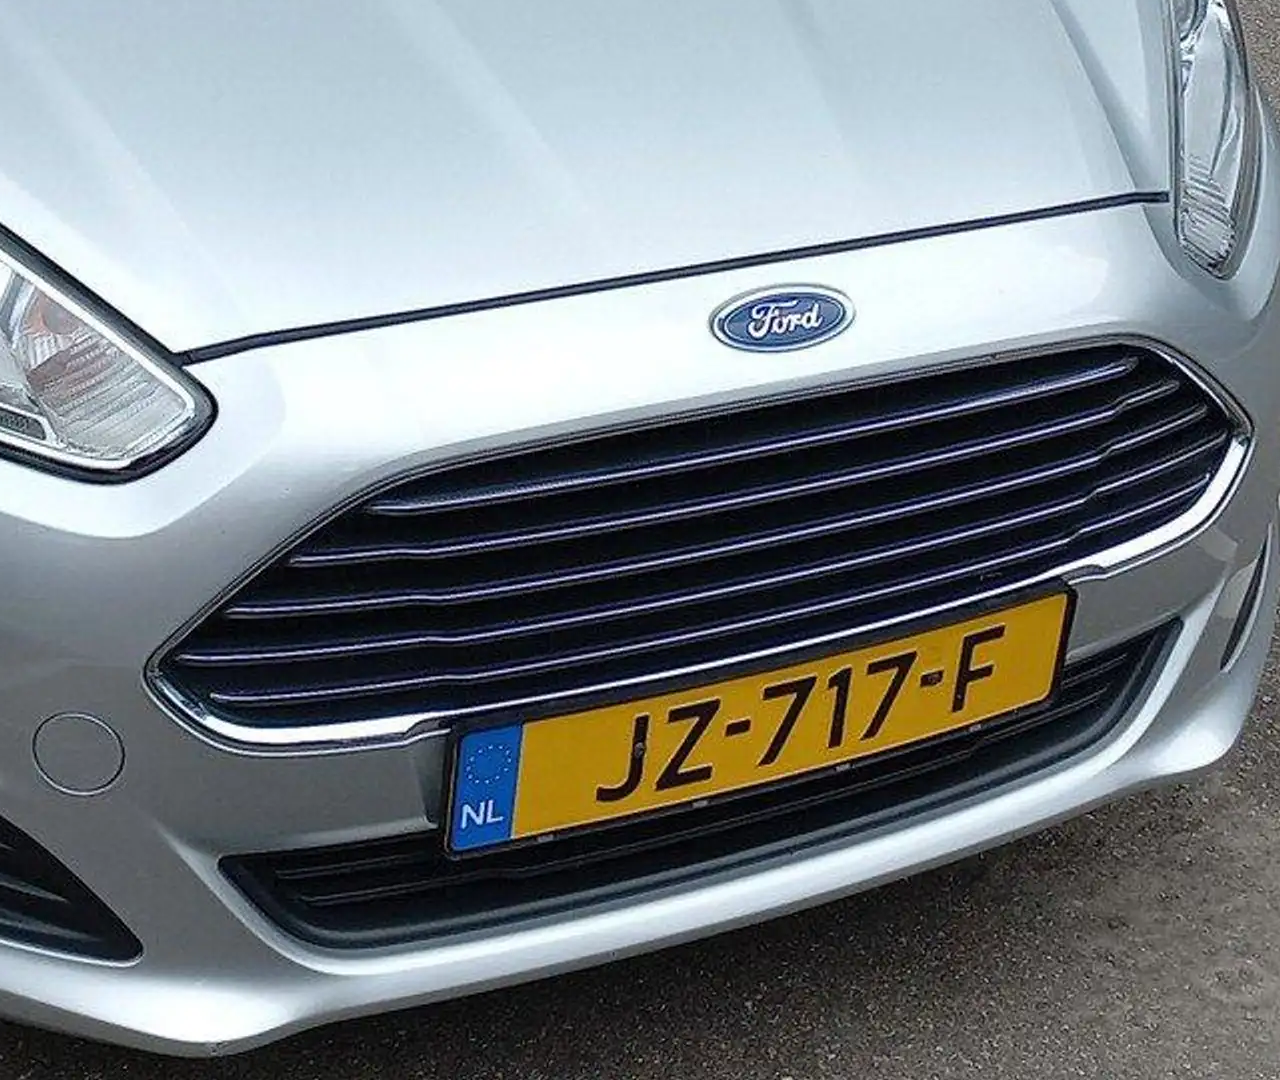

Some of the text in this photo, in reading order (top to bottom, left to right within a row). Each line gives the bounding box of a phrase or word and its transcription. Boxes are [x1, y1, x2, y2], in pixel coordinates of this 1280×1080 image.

[747, 298, 823, 340] Ford
[594, 624, 1006, 804] JZ-717-F
[460, 800, 505, 830] NL
